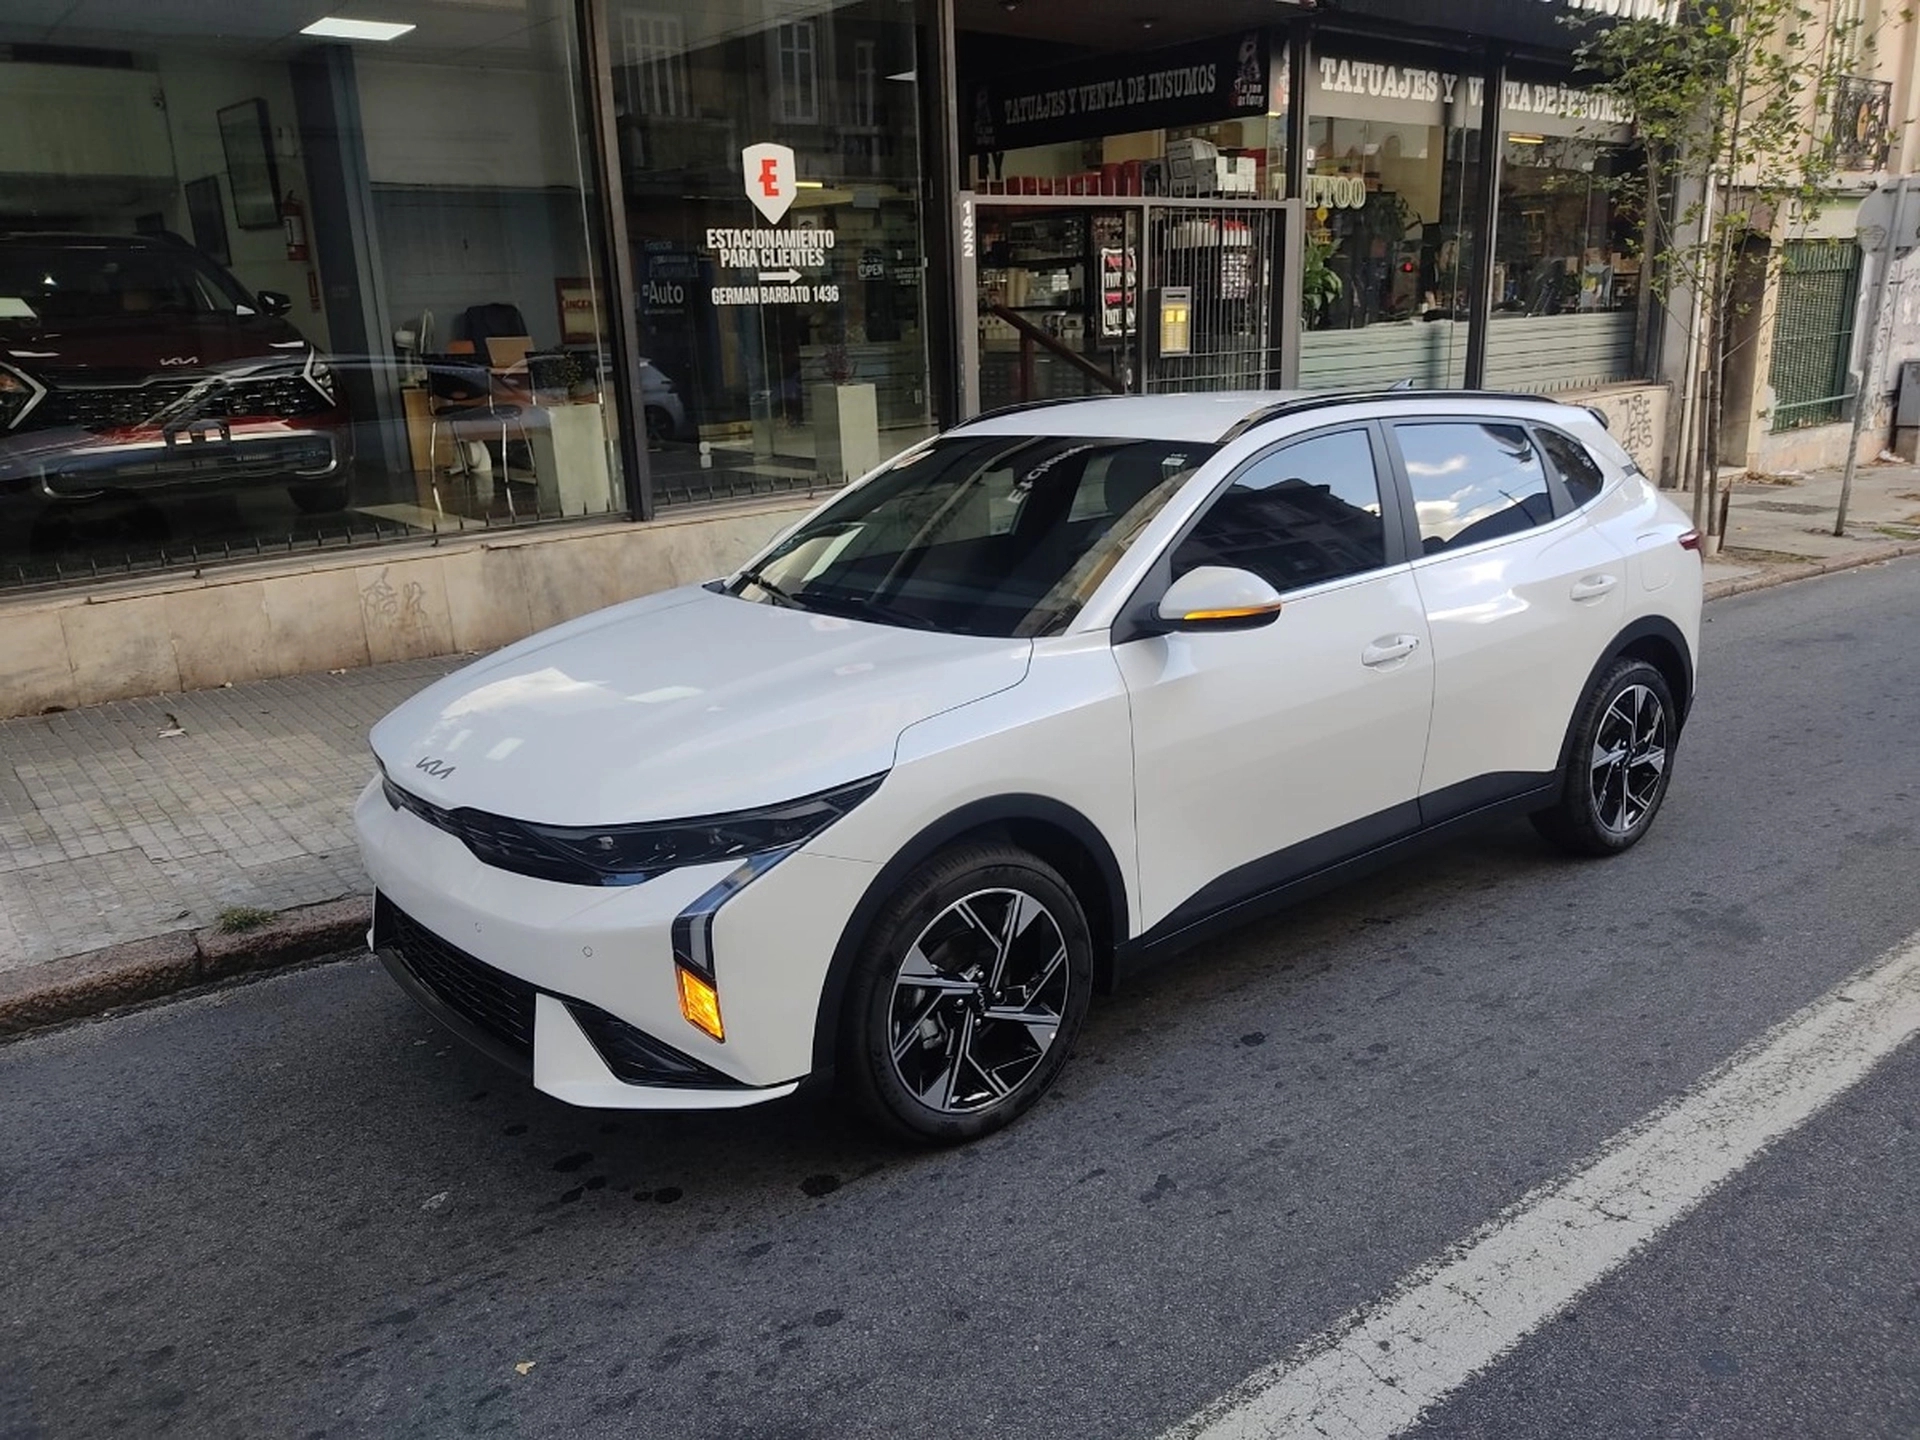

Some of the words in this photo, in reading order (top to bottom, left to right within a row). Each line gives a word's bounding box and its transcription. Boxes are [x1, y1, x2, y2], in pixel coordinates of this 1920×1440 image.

[1004, 87, 1066, 124] TATUAJES
[1069, 89, 1077, 114] Y
[1078, 78, 1124, 112] VENTA
[1127, 75, 1145, 104] DE
[1148, 64, 1216, 100] INSUMOS
[1320, 57, 1438, 102] TATUAJES
[1442, 73, 1457, 103] Y
[1468, 76, 1531, 112] VTA
[706, 229, 834, 249] ESTACIONAMIENTO
[962, 200, 974, 257] 1422
[720, 248, 759, 267] PARA
[761, 248, 824, 267] CLIENTES
[649, 280, 684, 304] Auto
[711, 286, 760, 305] GERMAN
[760, 285, 811, 304] BARBATO
[812, 285, 840, 302] 1436
